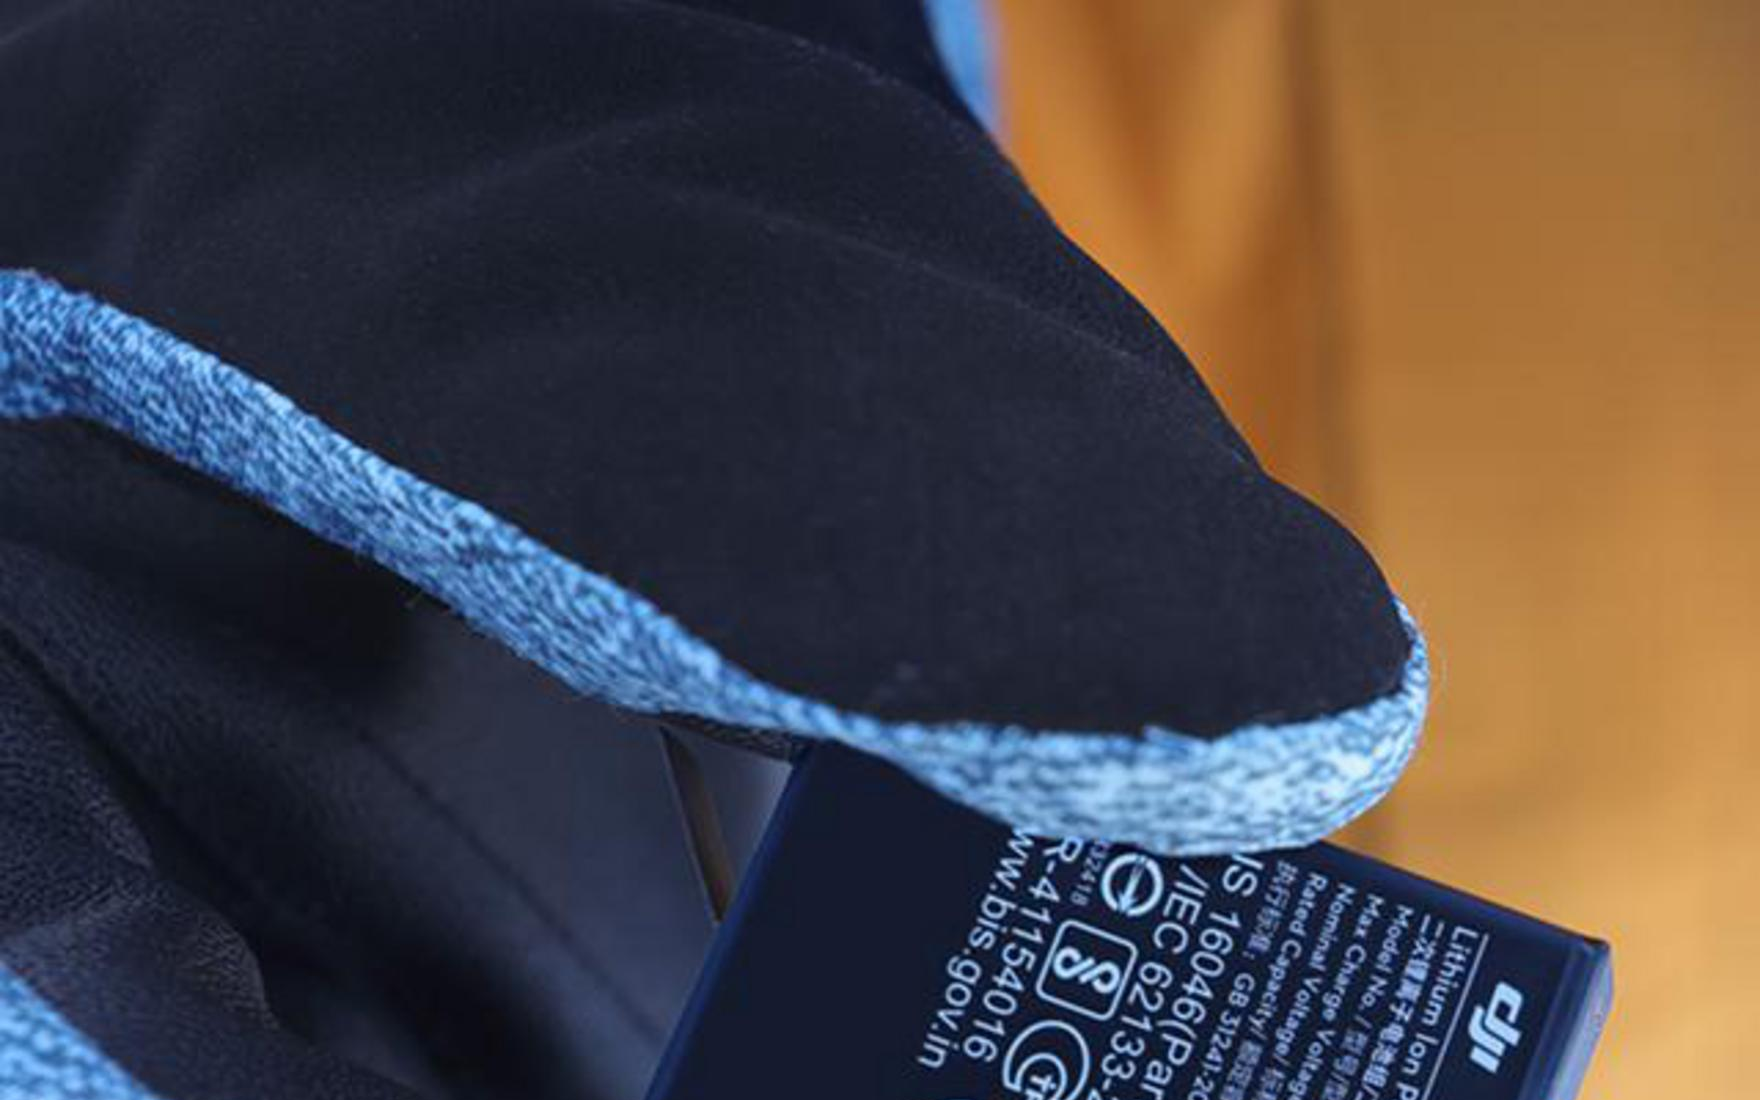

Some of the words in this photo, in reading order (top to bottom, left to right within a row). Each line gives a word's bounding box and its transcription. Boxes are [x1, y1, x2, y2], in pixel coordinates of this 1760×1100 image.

[962, 825, 1086, 1063] R-41154016
[1152, 863, 1210, 954] /IEC
[1288, 871, 1328, 937] Rated
[1307, 882, 1356, 972] Nominal
[1353, 893, 1385, 938] Max
[1374, 903, 1414, 973] Model
[1227, 971, 1256, 1008] GB
[1247, 938, 1302, 1040] Capacity/
[1321, 942, 1367, 1022] Charge
[1358, 974, 1388, 1010] No.
[1420, 925, 1479, 1026] Lithium
[1272, 976, 1323, 1066] Voltage/
[1401, 1031, 1439, 1076] Ion
